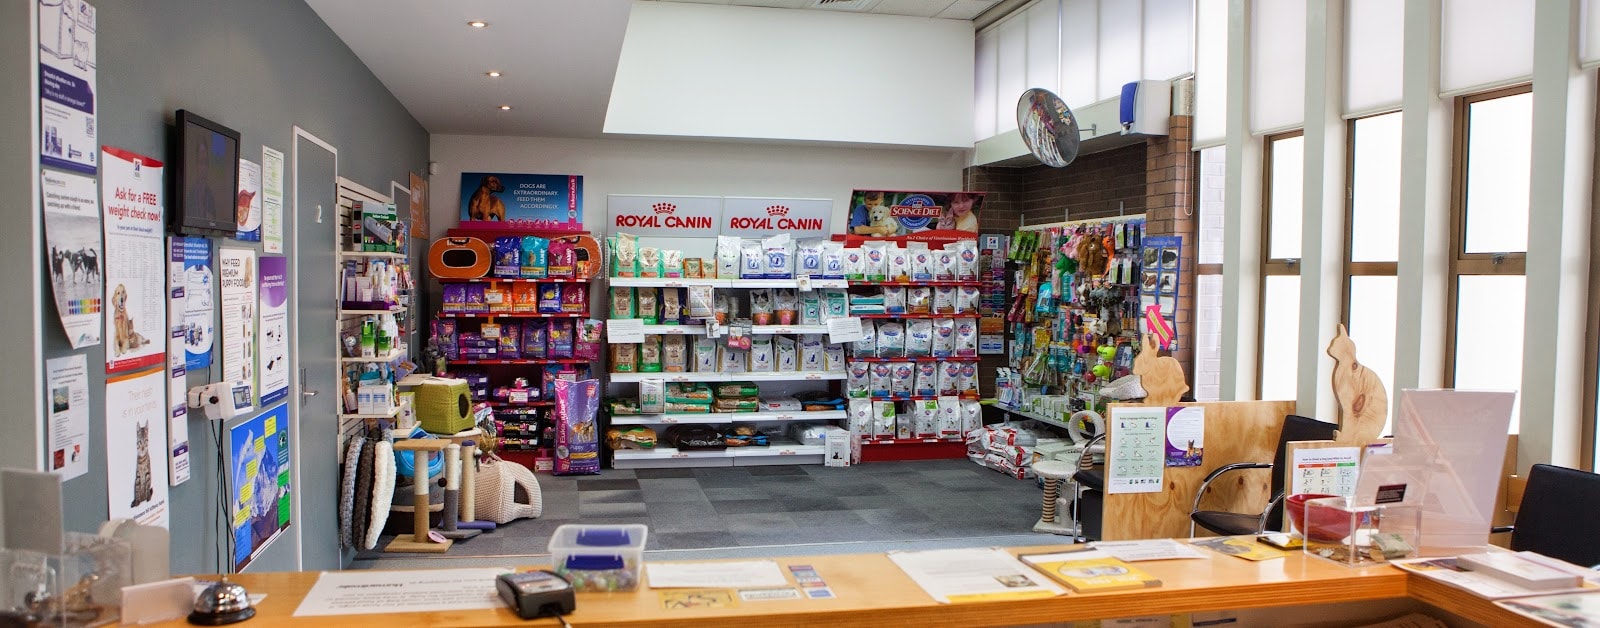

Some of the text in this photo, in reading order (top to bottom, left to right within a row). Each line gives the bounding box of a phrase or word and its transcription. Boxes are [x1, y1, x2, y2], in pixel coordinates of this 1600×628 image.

[115, 187, 156, 206] Ask for a FREE
[108, 203, 161, 222] weight check now!
[892, 207, 940, 216] SCIENCE DIET
[616, 215, 712, 229] ROYAL CANIN
[730, 217, 823, 230] ROYAL CANIN
[231, 258, 240, 267] FEED
